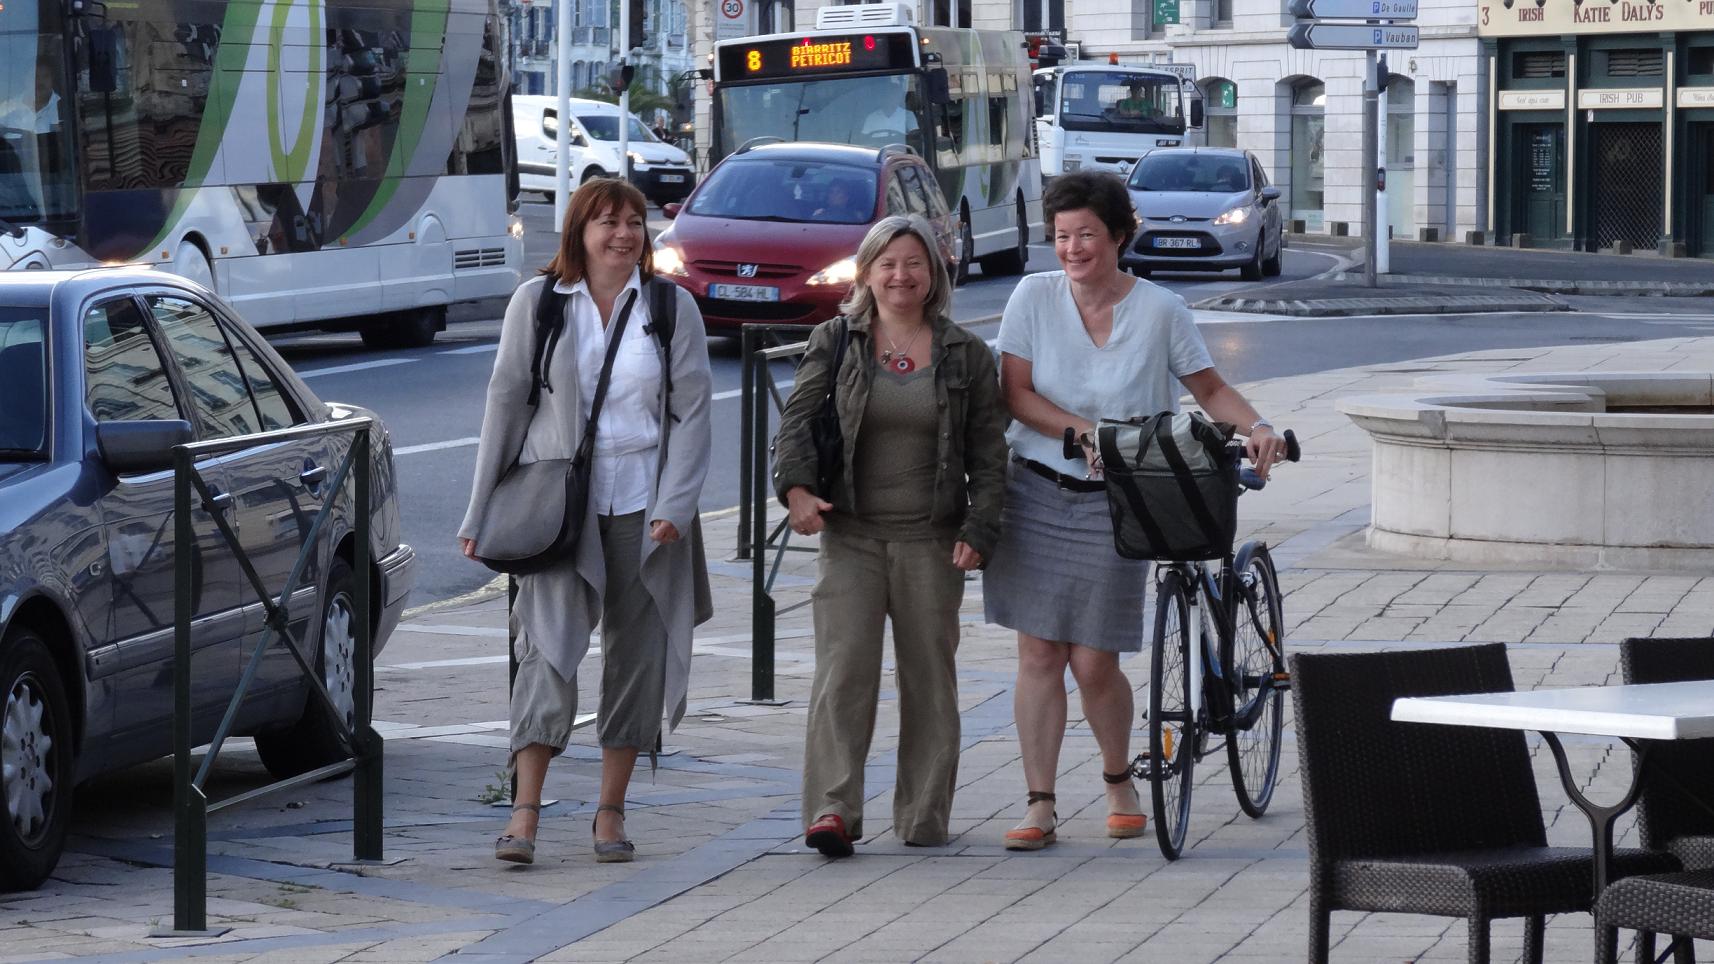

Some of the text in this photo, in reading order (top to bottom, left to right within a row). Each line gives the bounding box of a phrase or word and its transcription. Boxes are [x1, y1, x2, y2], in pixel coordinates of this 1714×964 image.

[727, 3, 739, 12] 30
[1382, 3, 1390, 12] De
[1393, 3, 1415, 12] Gaulle
[1482, 1, 1714, 26] 3 IRISH KATIE DALY'S PU
[1386, 32, 1416, 43] Vauban
[792, 42, 851, 55] BIARRITZ
[747, 50, 761, 71] 8
[791, 53, 850, 67] PETRICOT
[1600, 92, 1644, 104] IRISH PUB
